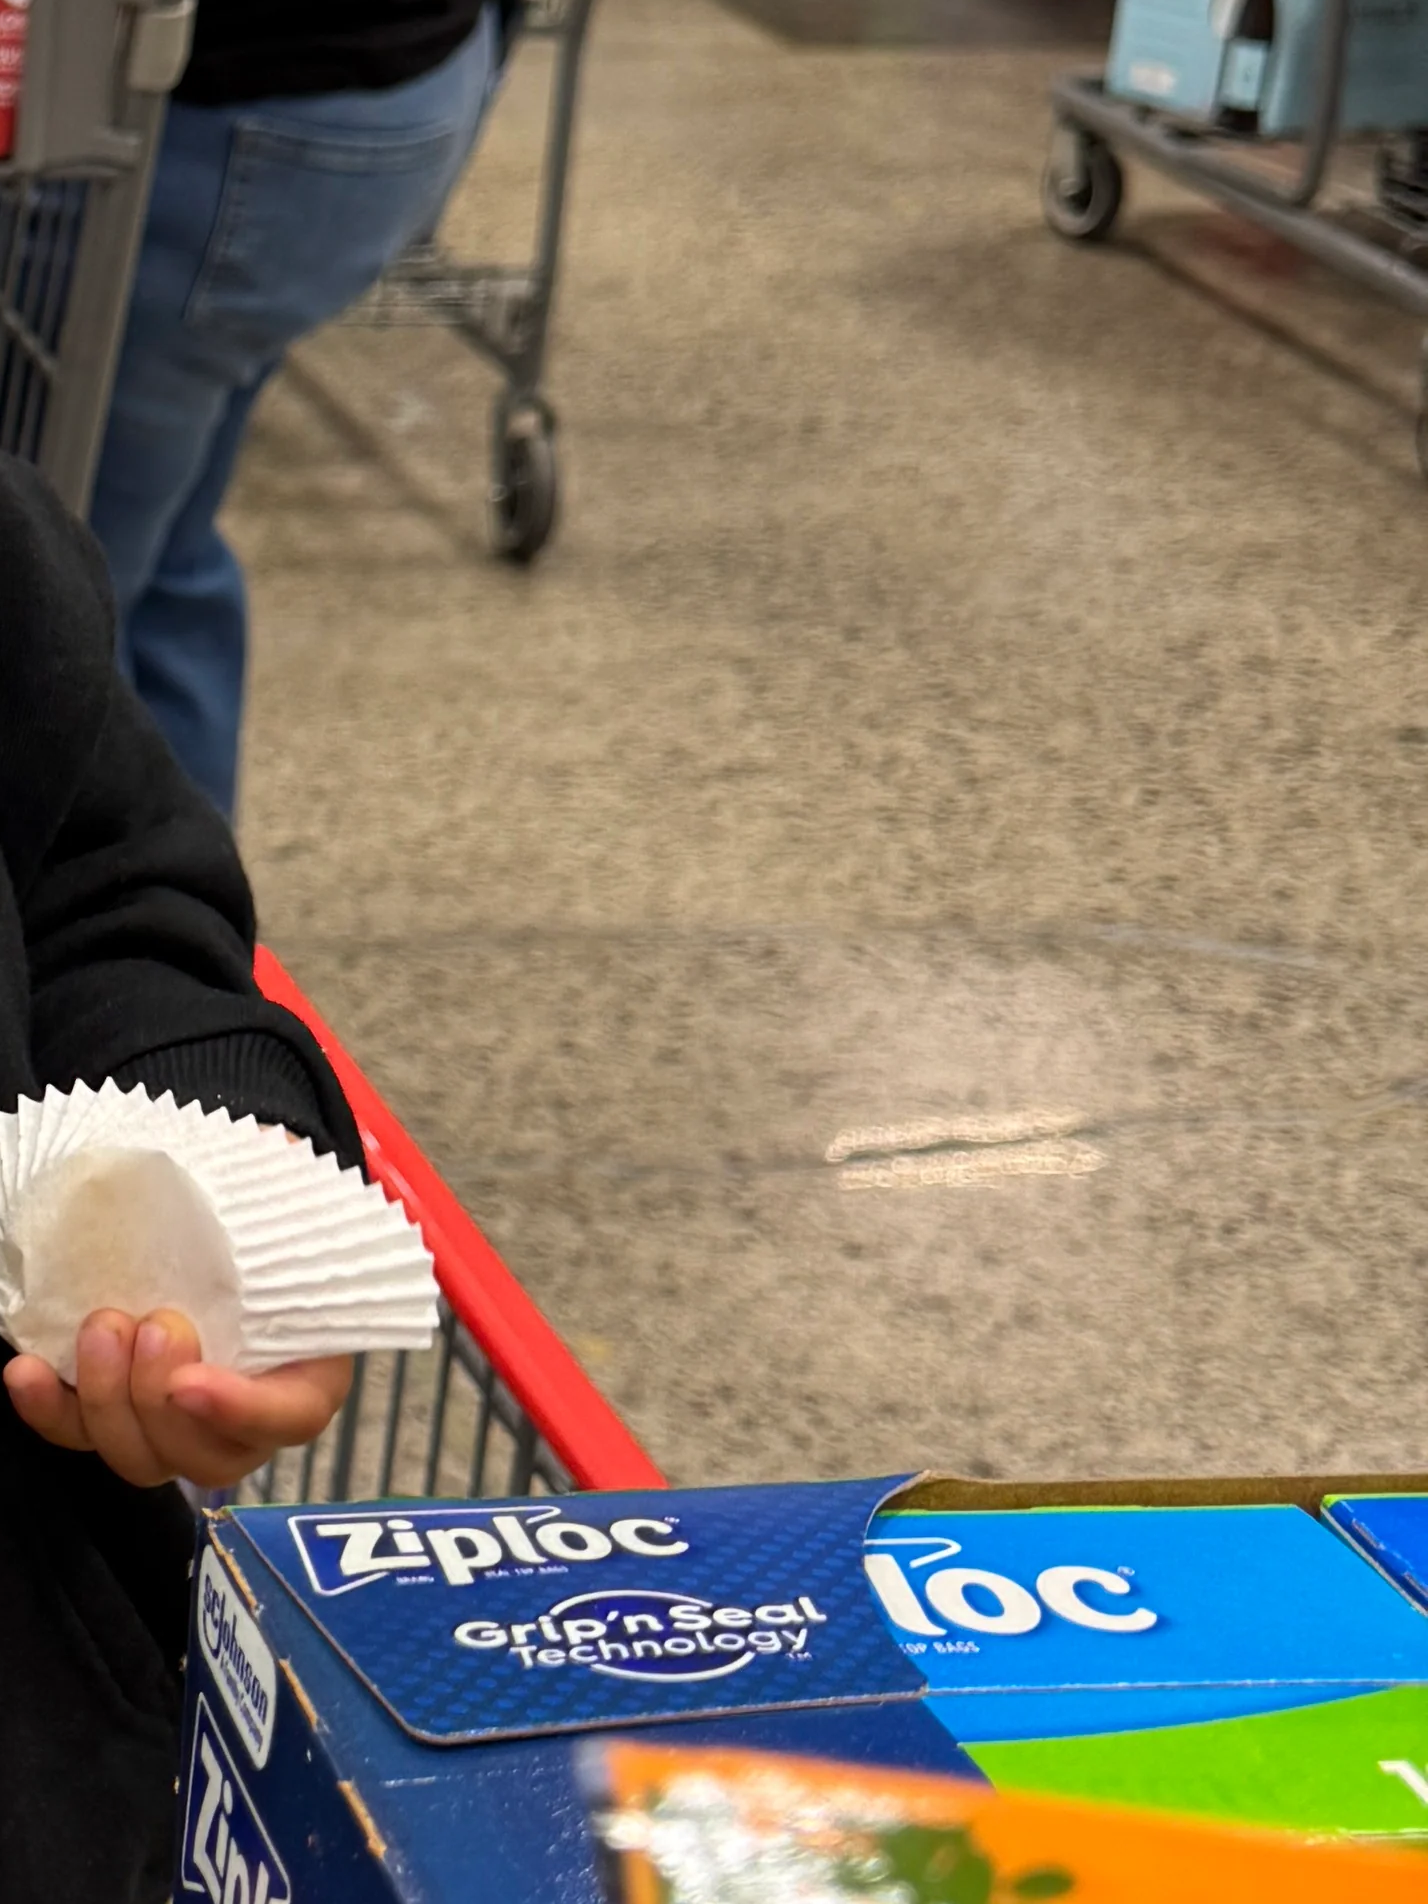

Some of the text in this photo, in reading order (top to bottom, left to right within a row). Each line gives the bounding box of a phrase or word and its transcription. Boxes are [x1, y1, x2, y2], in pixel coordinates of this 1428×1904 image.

[316, 1515, 690, 1586] Ziploc
[670, 1597, 827, 1633] Seal
[511, 1626, 808, 1668] Technology
[933, 1641, 980, 1655] BAGS
